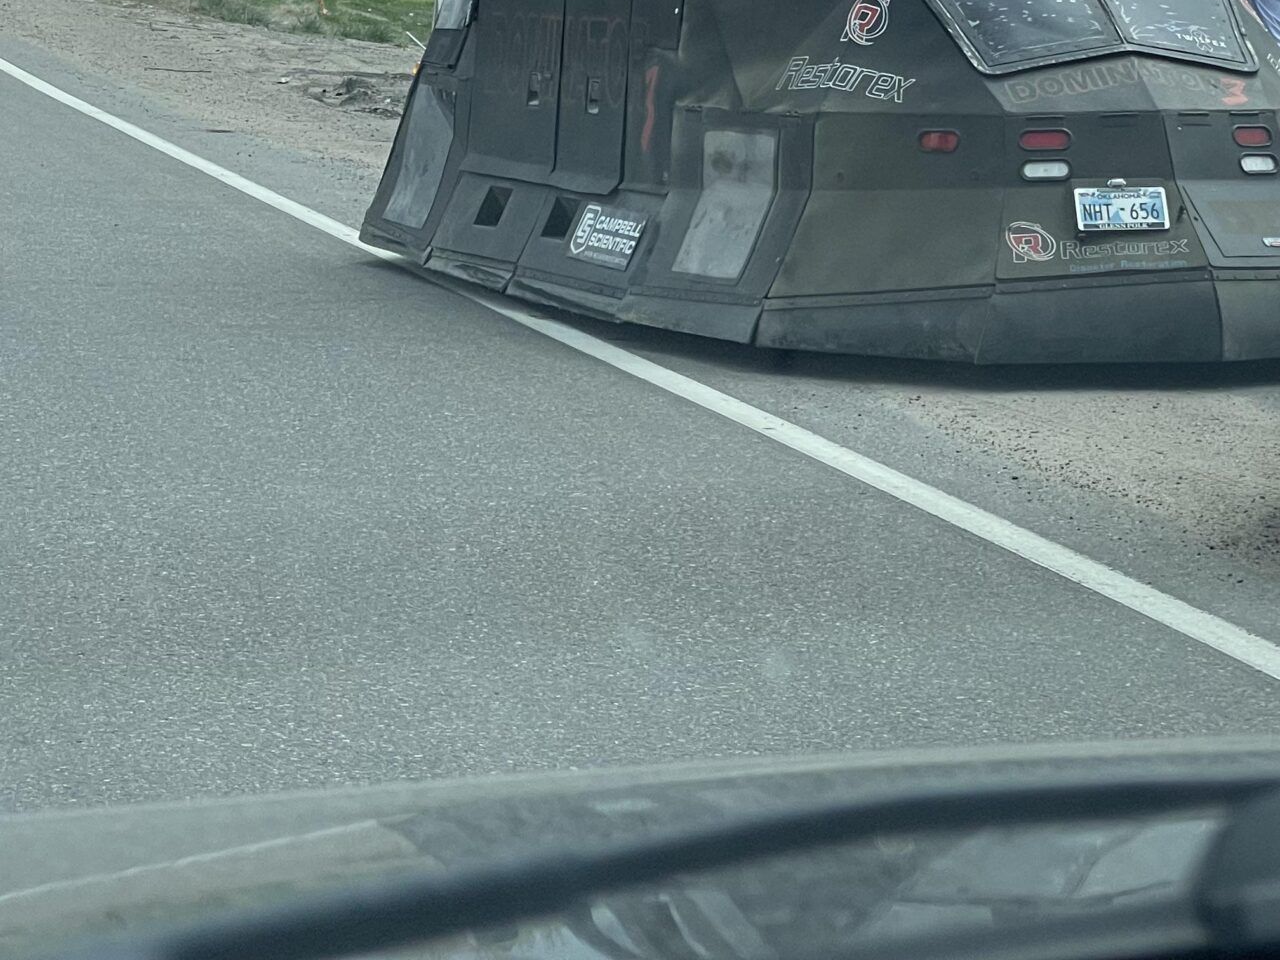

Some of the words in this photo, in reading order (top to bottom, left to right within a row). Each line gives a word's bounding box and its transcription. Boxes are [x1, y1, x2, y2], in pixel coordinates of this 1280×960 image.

[776, 56, 916, 103] Restorex
[1007, 57, 1220, 104] DOMINATO
[1097, 192, 1142, 200] OKLAHOMA
[596, 216, 642, 238] CAMPBELL
[588, 232, 636, 255] SCIENTIFIC
[1060, 239, 1190, 260] Restorex
